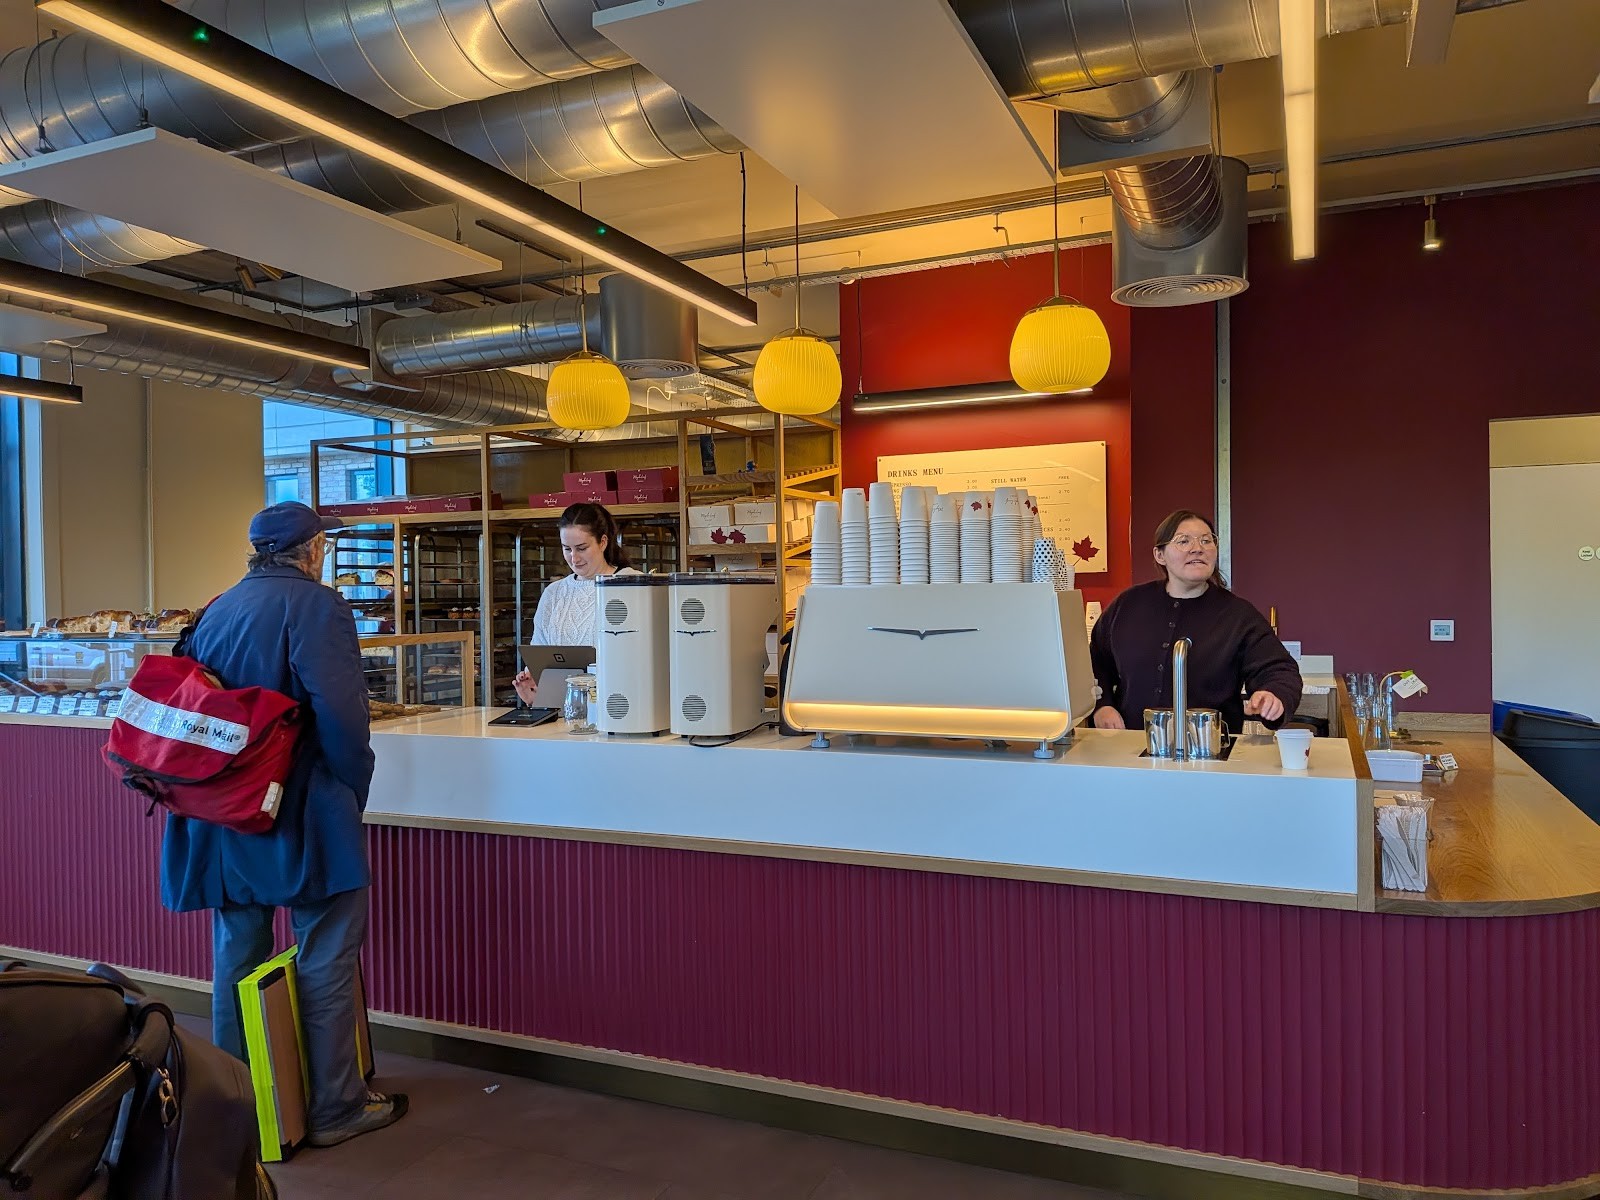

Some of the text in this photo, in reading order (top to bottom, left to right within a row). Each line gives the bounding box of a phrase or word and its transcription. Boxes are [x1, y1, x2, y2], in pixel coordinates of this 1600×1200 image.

[887, 467, 944, 478] DRINKS MENU
[181, 720, 209, 735] Royal
